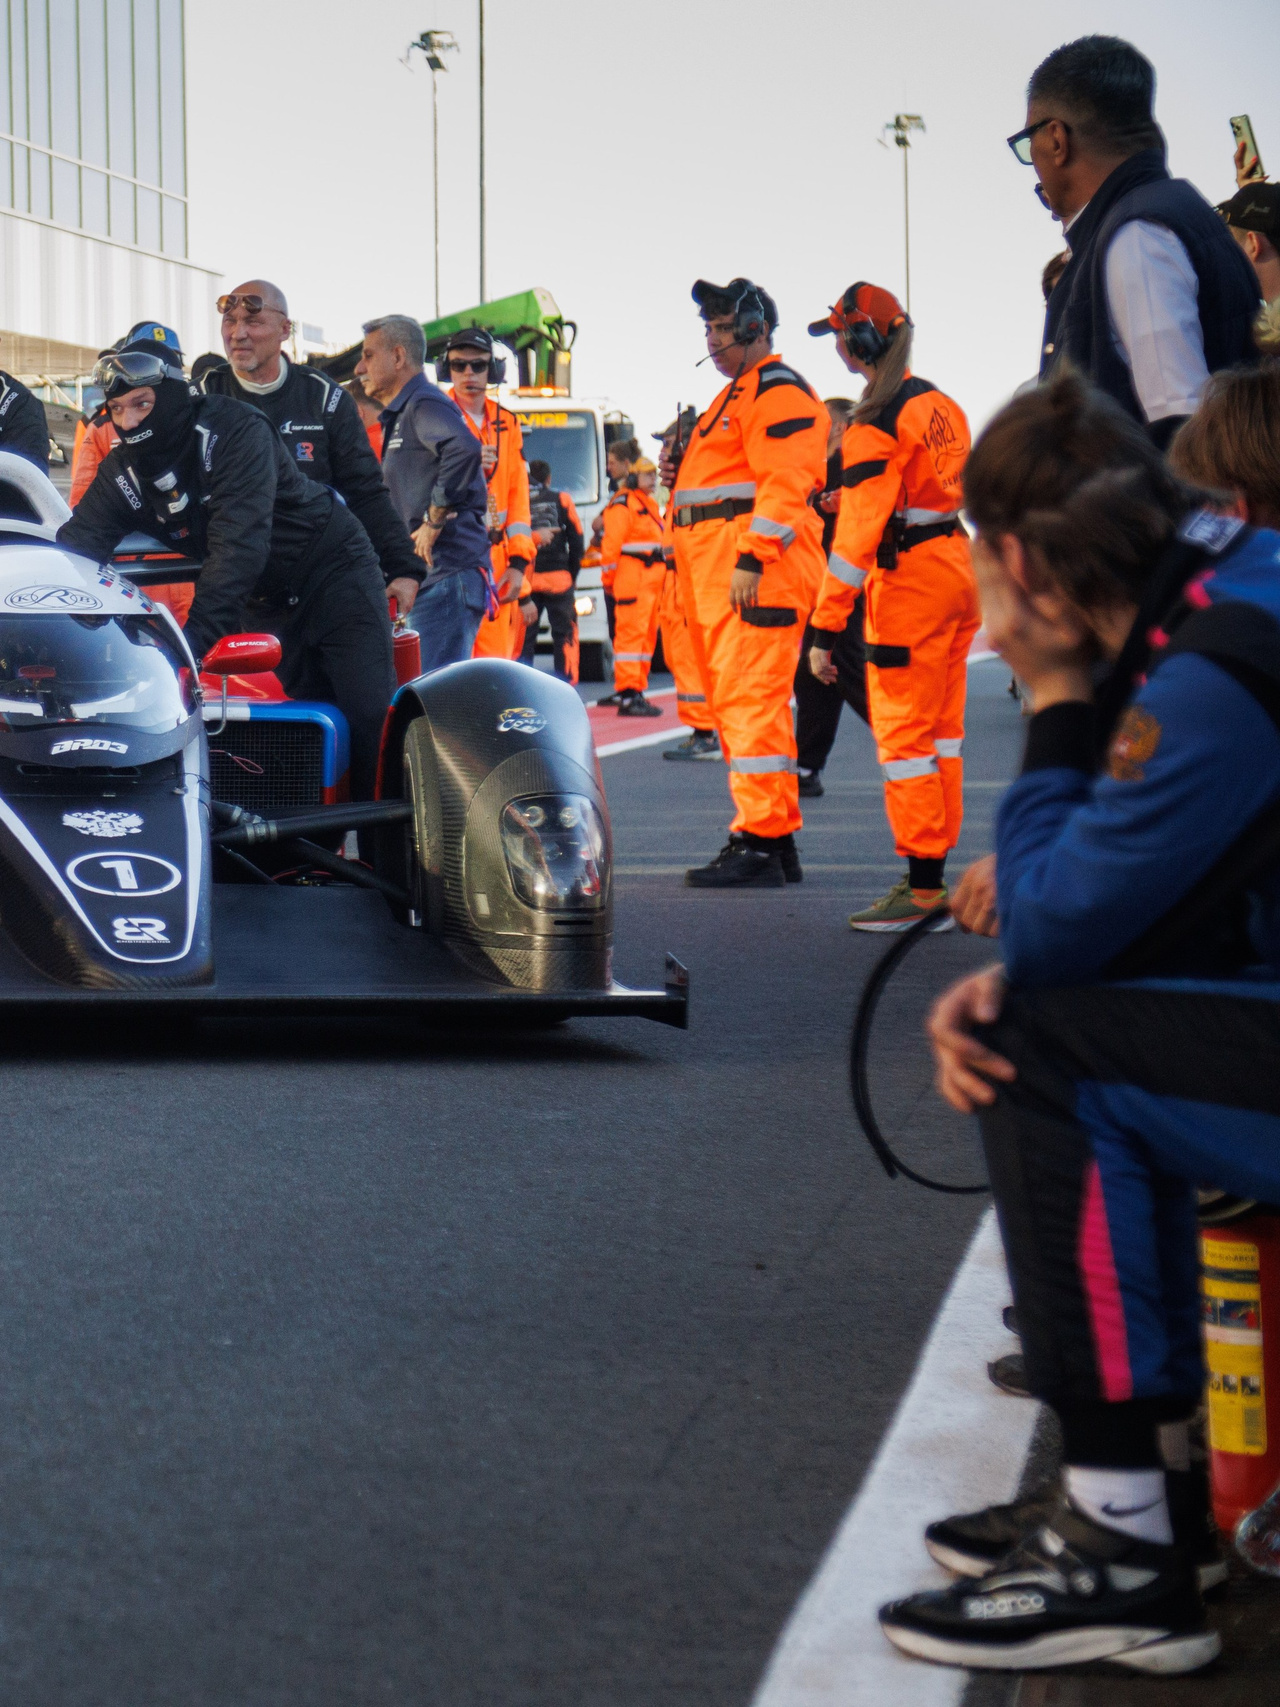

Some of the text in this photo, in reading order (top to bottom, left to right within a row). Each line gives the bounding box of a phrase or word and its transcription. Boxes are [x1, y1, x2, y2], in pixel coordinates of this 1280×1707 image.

[125, 429, 154, 444] sparco
[115, 475, 142, 511] sparco
[100, 860, 138, 889] 1
[966, 1592, 1046, 1619] sparco
